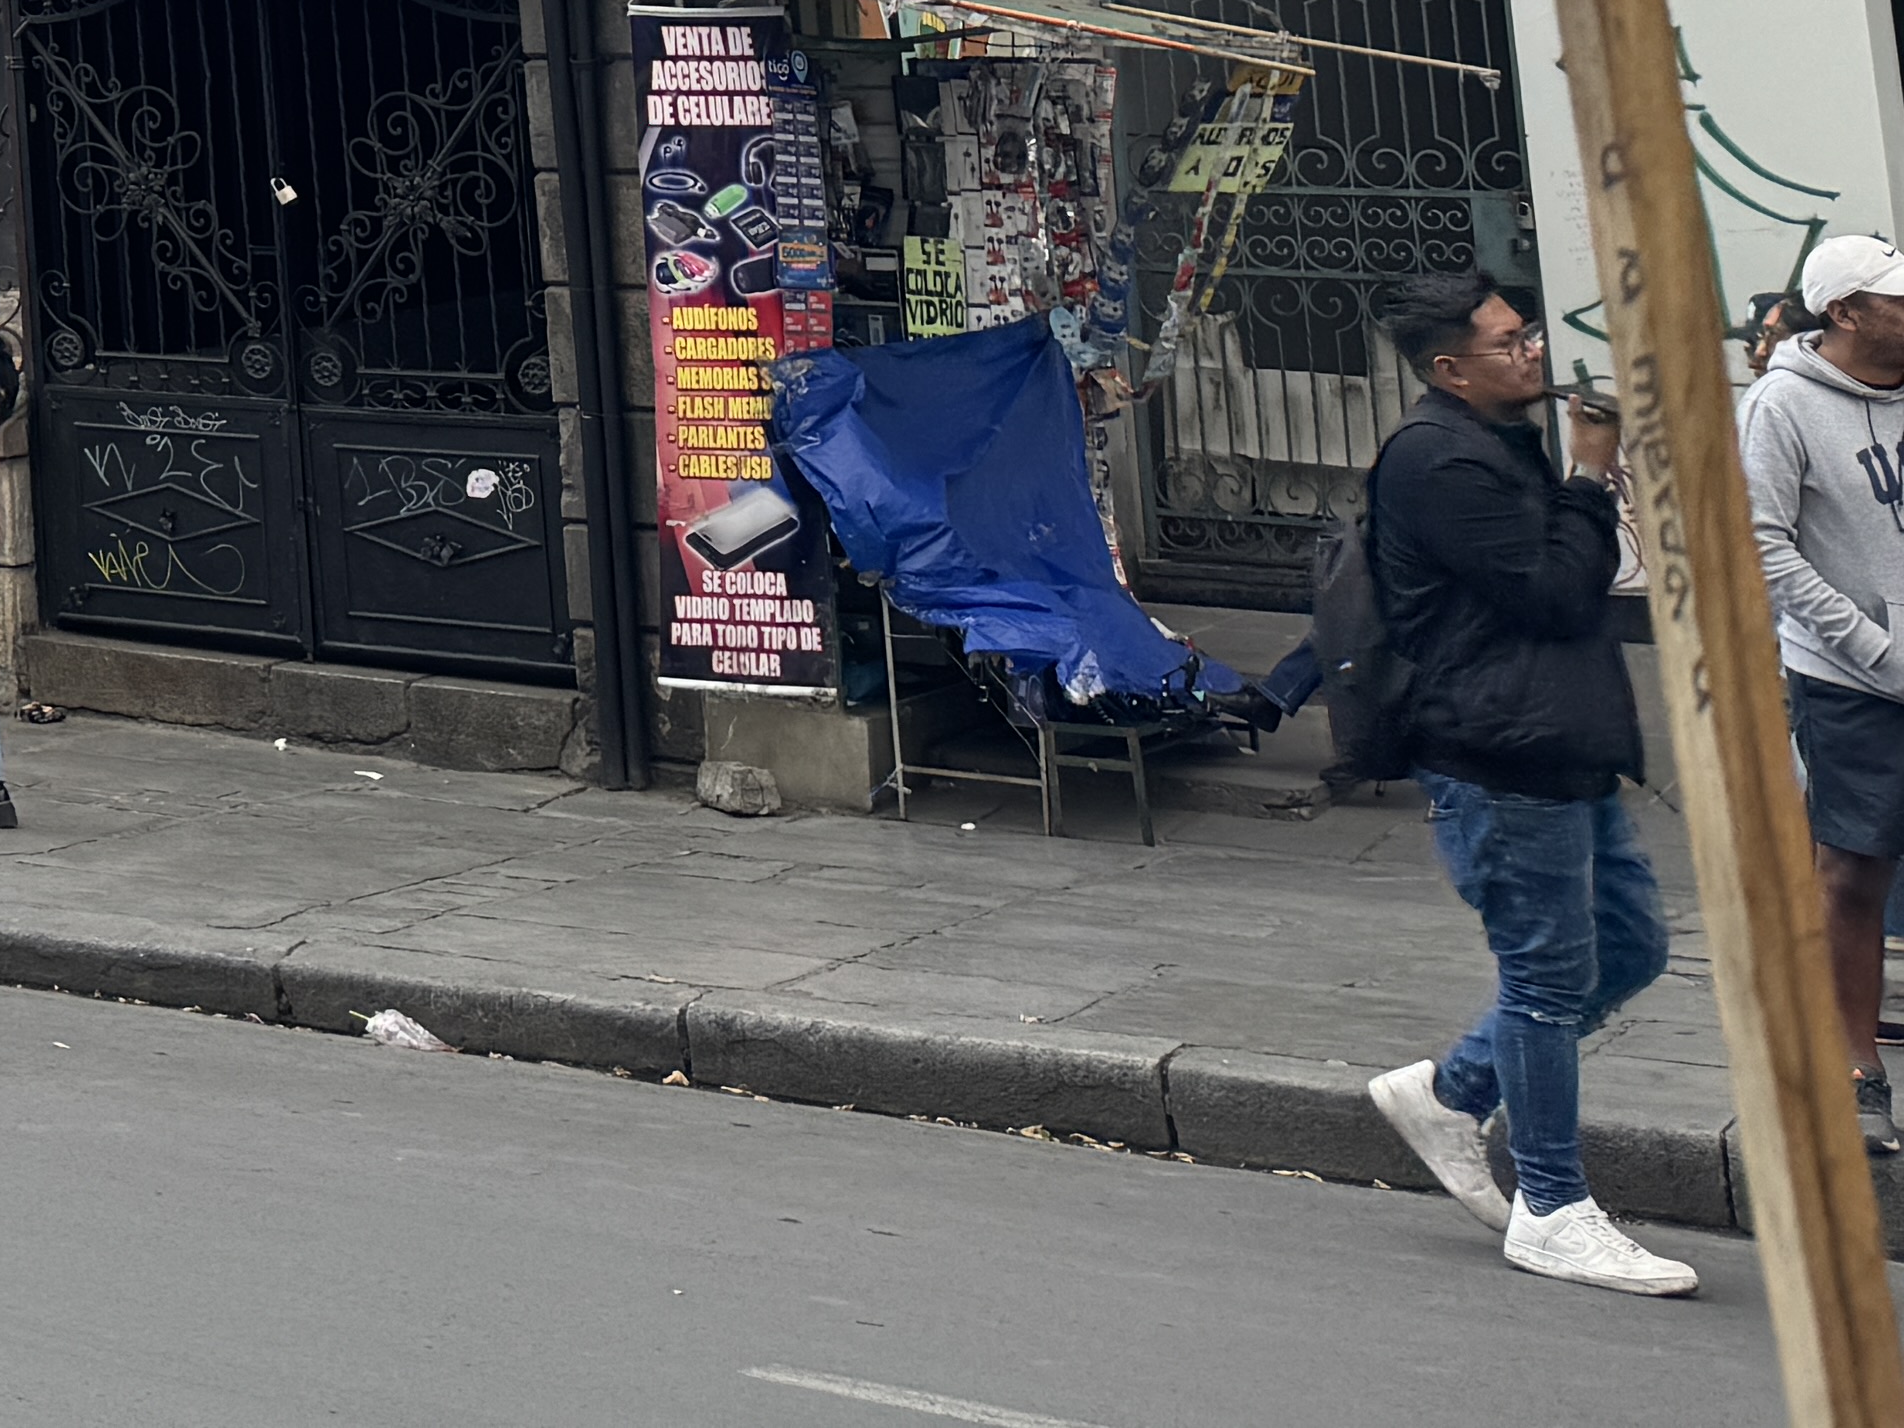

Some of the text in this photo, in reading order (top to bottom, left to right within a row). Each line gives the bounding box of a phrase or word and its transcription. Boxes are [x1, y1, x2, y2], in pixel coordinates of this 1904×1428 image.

[661, 26, 754, 56] VENTA DE
[647, 95, 774, 126] DE CELULARE
[920, 237, 945, 266] SE
[906, 267, 963, 299] COLOCA
[672, 304, 758, 330] AUDÍFONOS
[907, 298, 964, 328] VIDRIO
[675, 337, 775, 360] CARGADORES
[677, 367, 758, 390] MEMORIAS
[677, 396, 772, 421] FLASH MEMO
[677, 425, 766, 449] PARLANTES
[678, 455, 773, 480] CABLES USB
[702, 570, 787, 596] SE COLOCA
[674, 596, 814, 624] VIDRIO TEMPLADO
[670, 623, 823, 651] PARA TODO TIPO DE
[711, 650, 782, 678] CELULAR
